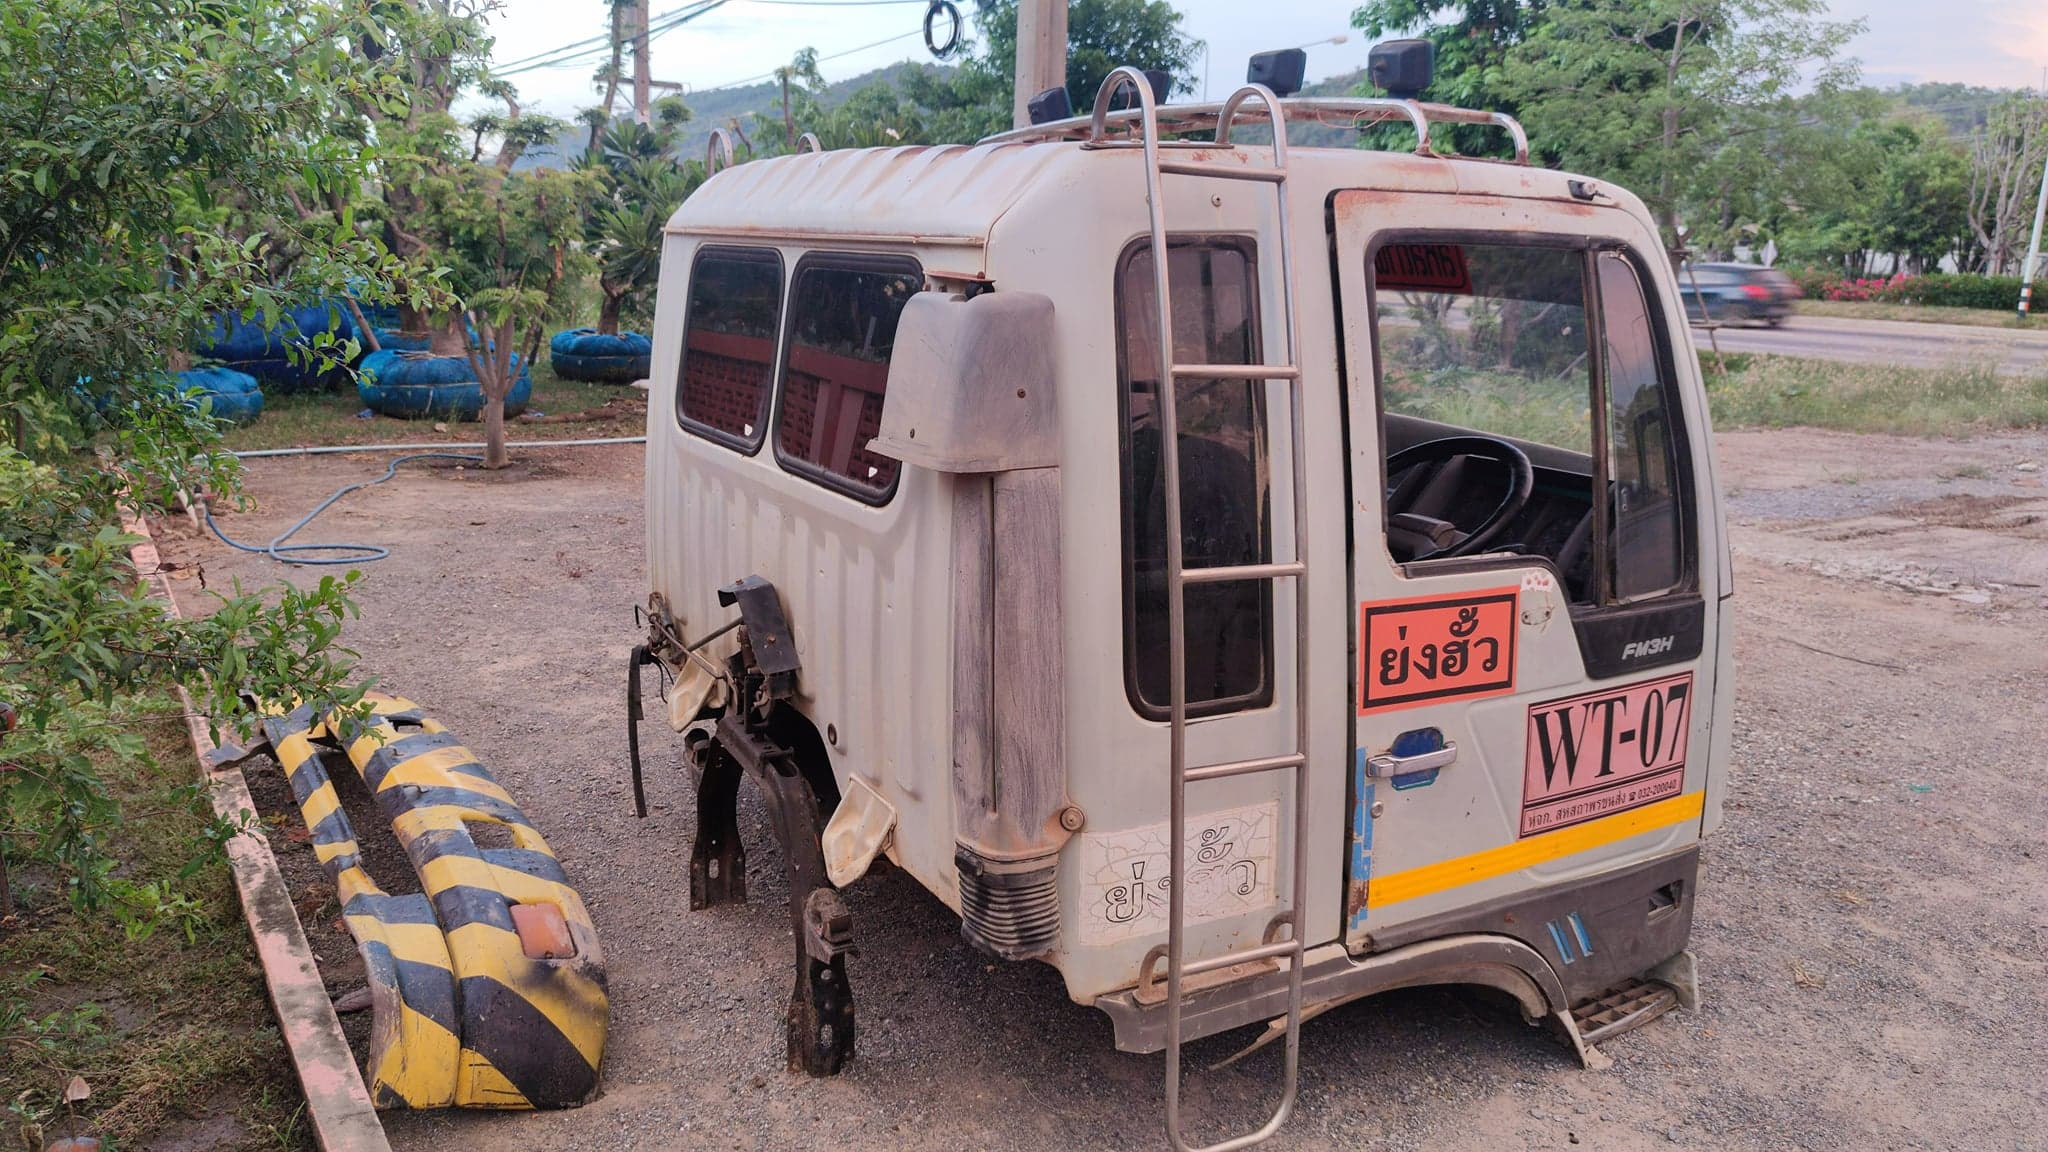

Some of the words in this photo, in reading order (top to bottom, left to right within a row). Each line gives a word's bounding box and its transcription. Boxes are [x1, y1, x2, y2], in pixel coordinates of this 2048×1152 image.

[1379, 607, 1499, 686] ย่งฮั้ว
[1622, 635, 1673, 660] FM3H
[1532, 682, 1690, 793] WT-07
